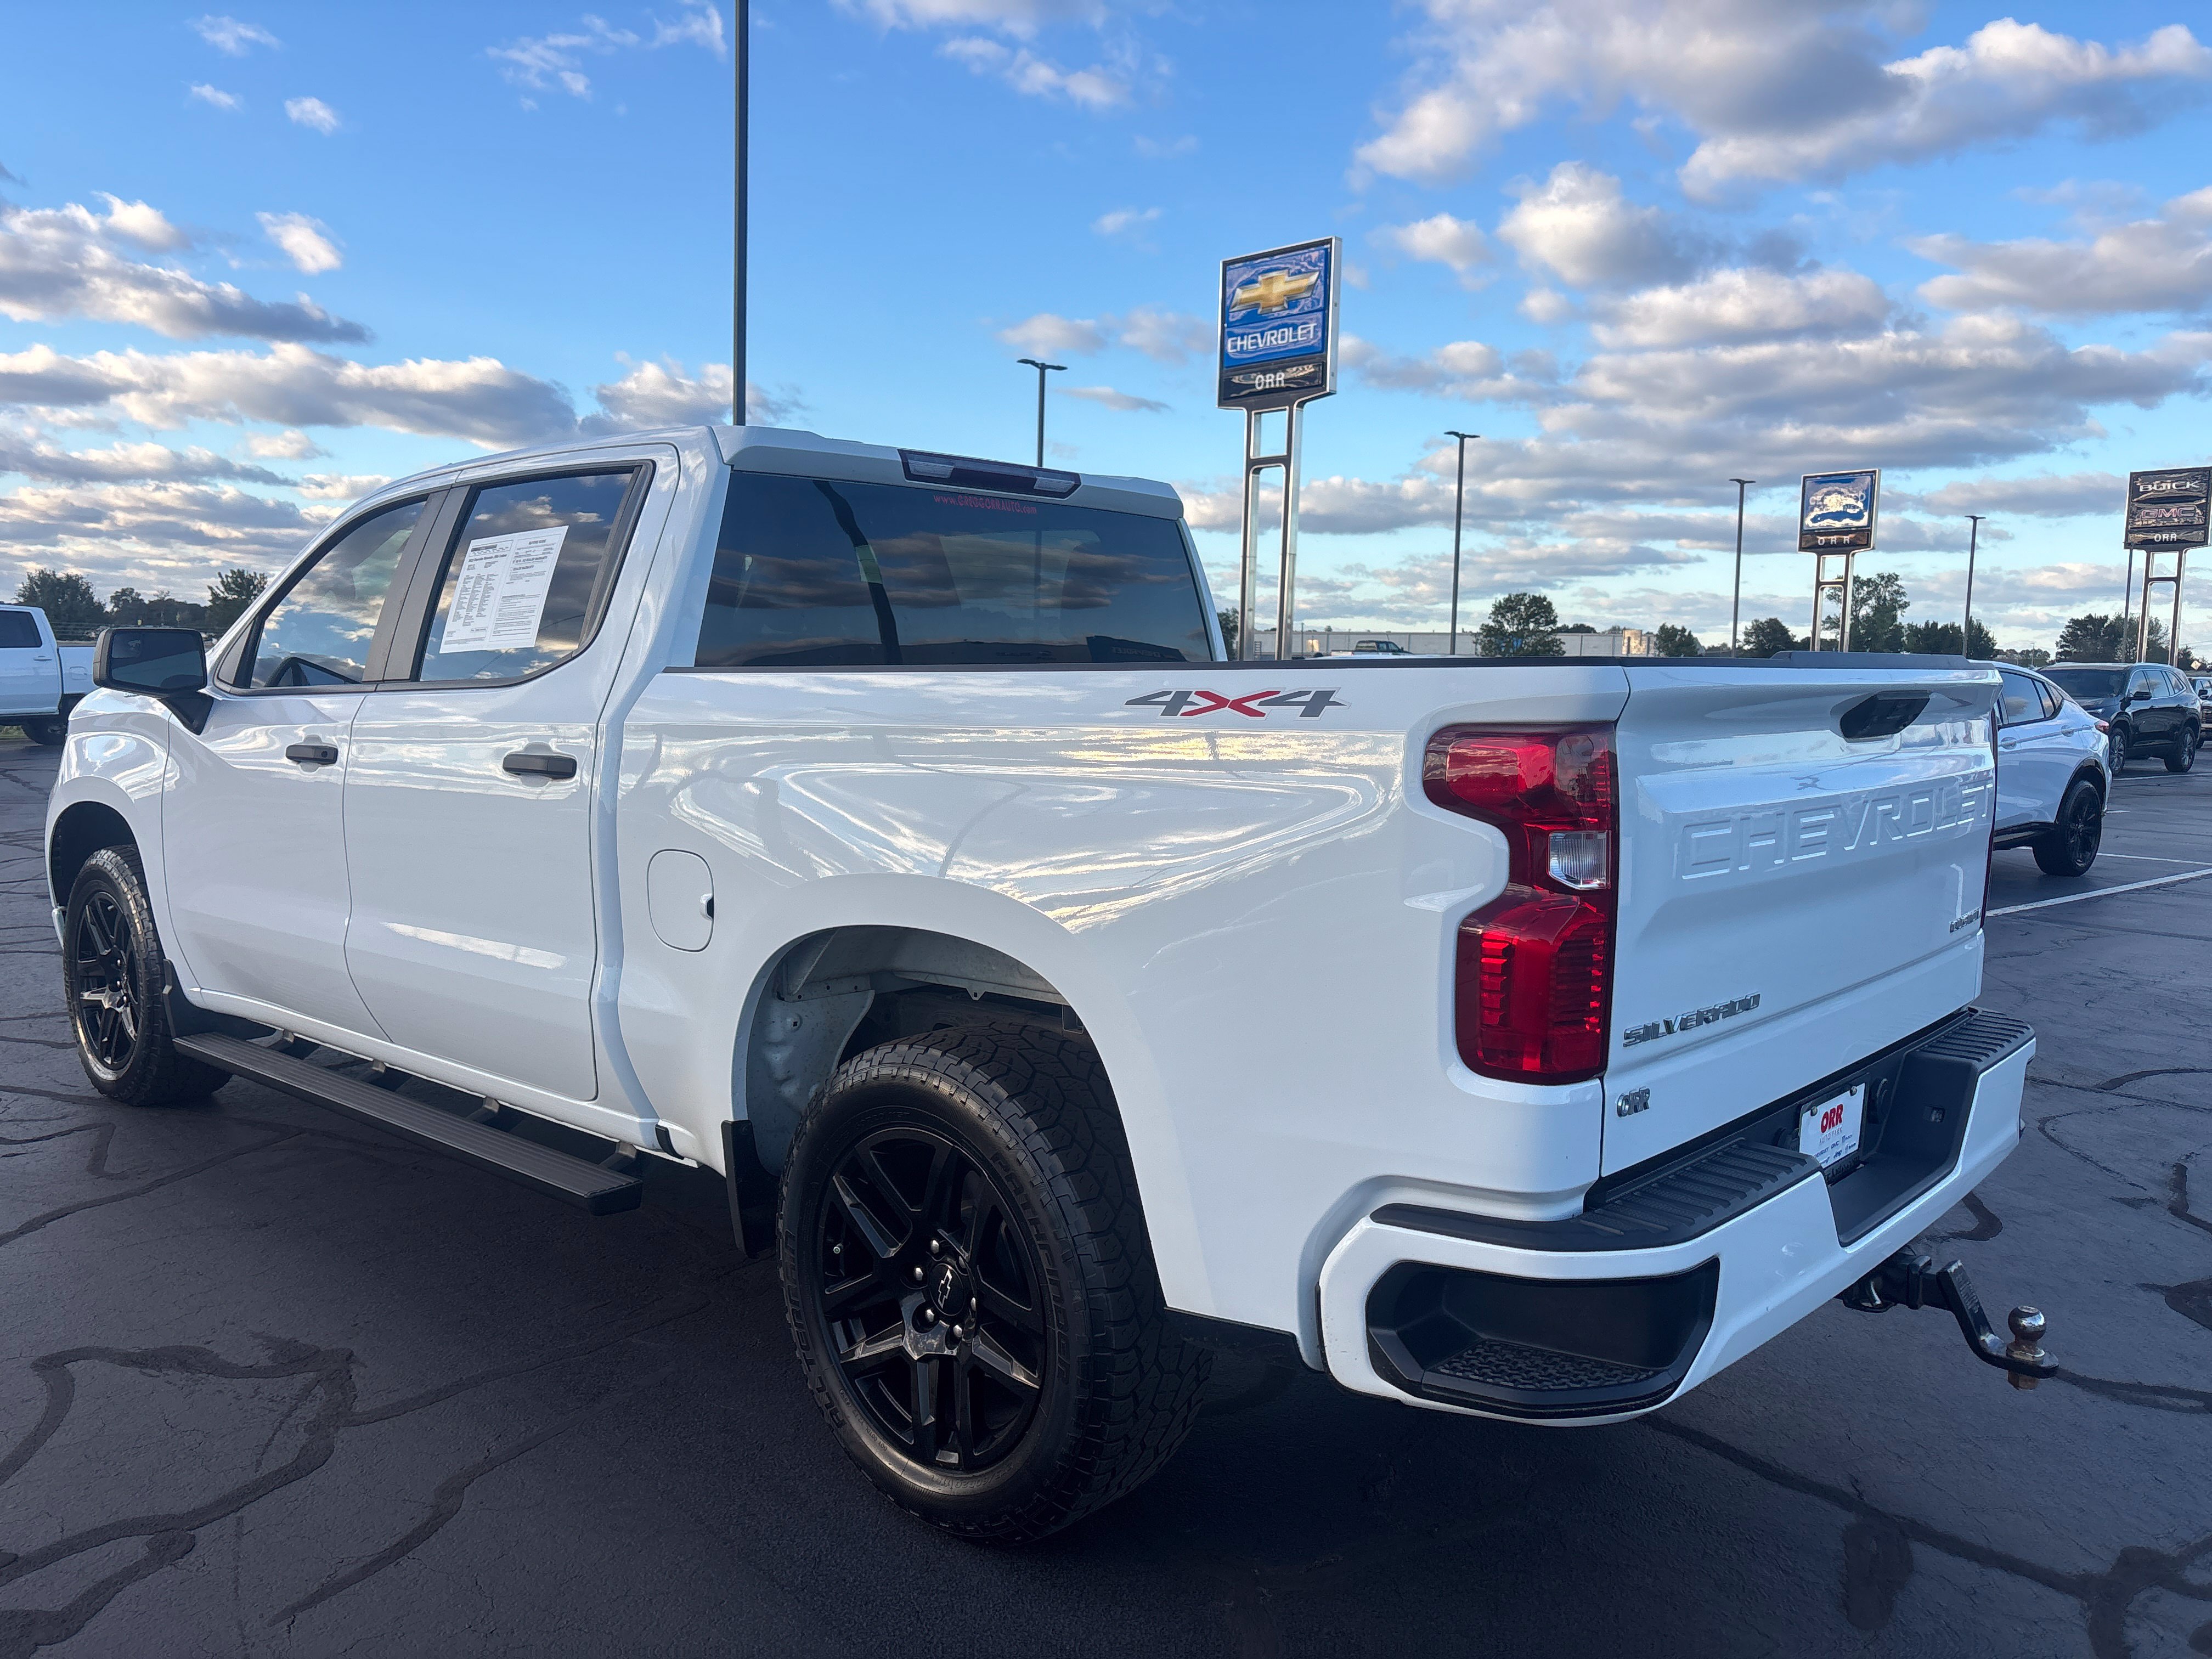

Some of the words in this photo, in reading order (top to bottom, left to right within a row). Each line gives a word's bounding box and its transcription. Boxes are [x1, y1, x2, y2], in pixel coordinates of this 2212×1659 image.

[1227, 323, 1317, 353] CHEVROLET
[1255, 372, 1285, 390] ORR
[2139, 480, 2201, 492] BUICK
[2141, 507, 2195, 519] GMC
[1818, 536, 1850, 546] ORR
[2154, 533, 2177, 542] ORR
[1679, 781, 1993, 881] CHEVROLET
[1623, 991, 1761, 1047] SILVERADO
[1617, 1086, 1651, 1118] ORR
[1820, 1103, 1843, 1133] ORR
[989, 1147, 1070, 1386] PATHFINDER
